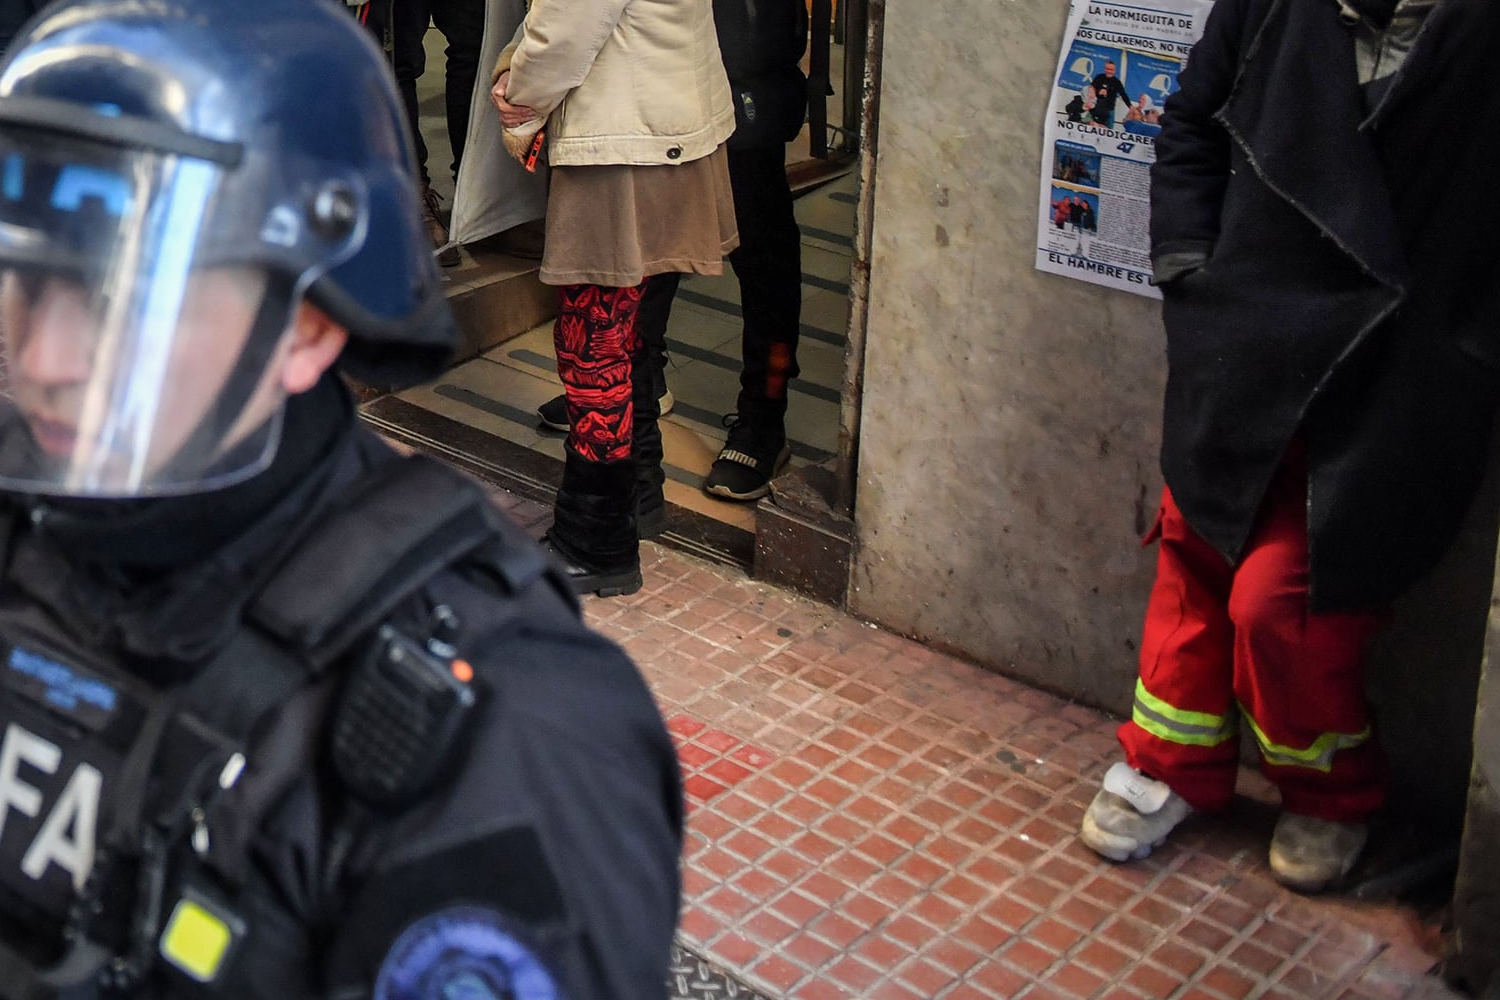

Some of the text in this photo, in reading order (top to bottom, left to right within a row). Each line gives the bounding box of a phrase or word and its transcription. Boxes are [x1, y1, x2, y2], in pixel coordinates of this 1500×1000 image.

[1088, 5, 1192, 30] LA HORMIGUITA DE
[1095, 31, 1157, 50] CALLAREMOS,
[1160, 42, 1174, 52] NO
[1058, 120, 1074, 130] NO
[1049, 252, 1063, 265] EL
[1068, 258, 1122, 279] HAMBRE
[1127, 272, 1143, 284] ES
[719, 448, 758, 468] PUMA
